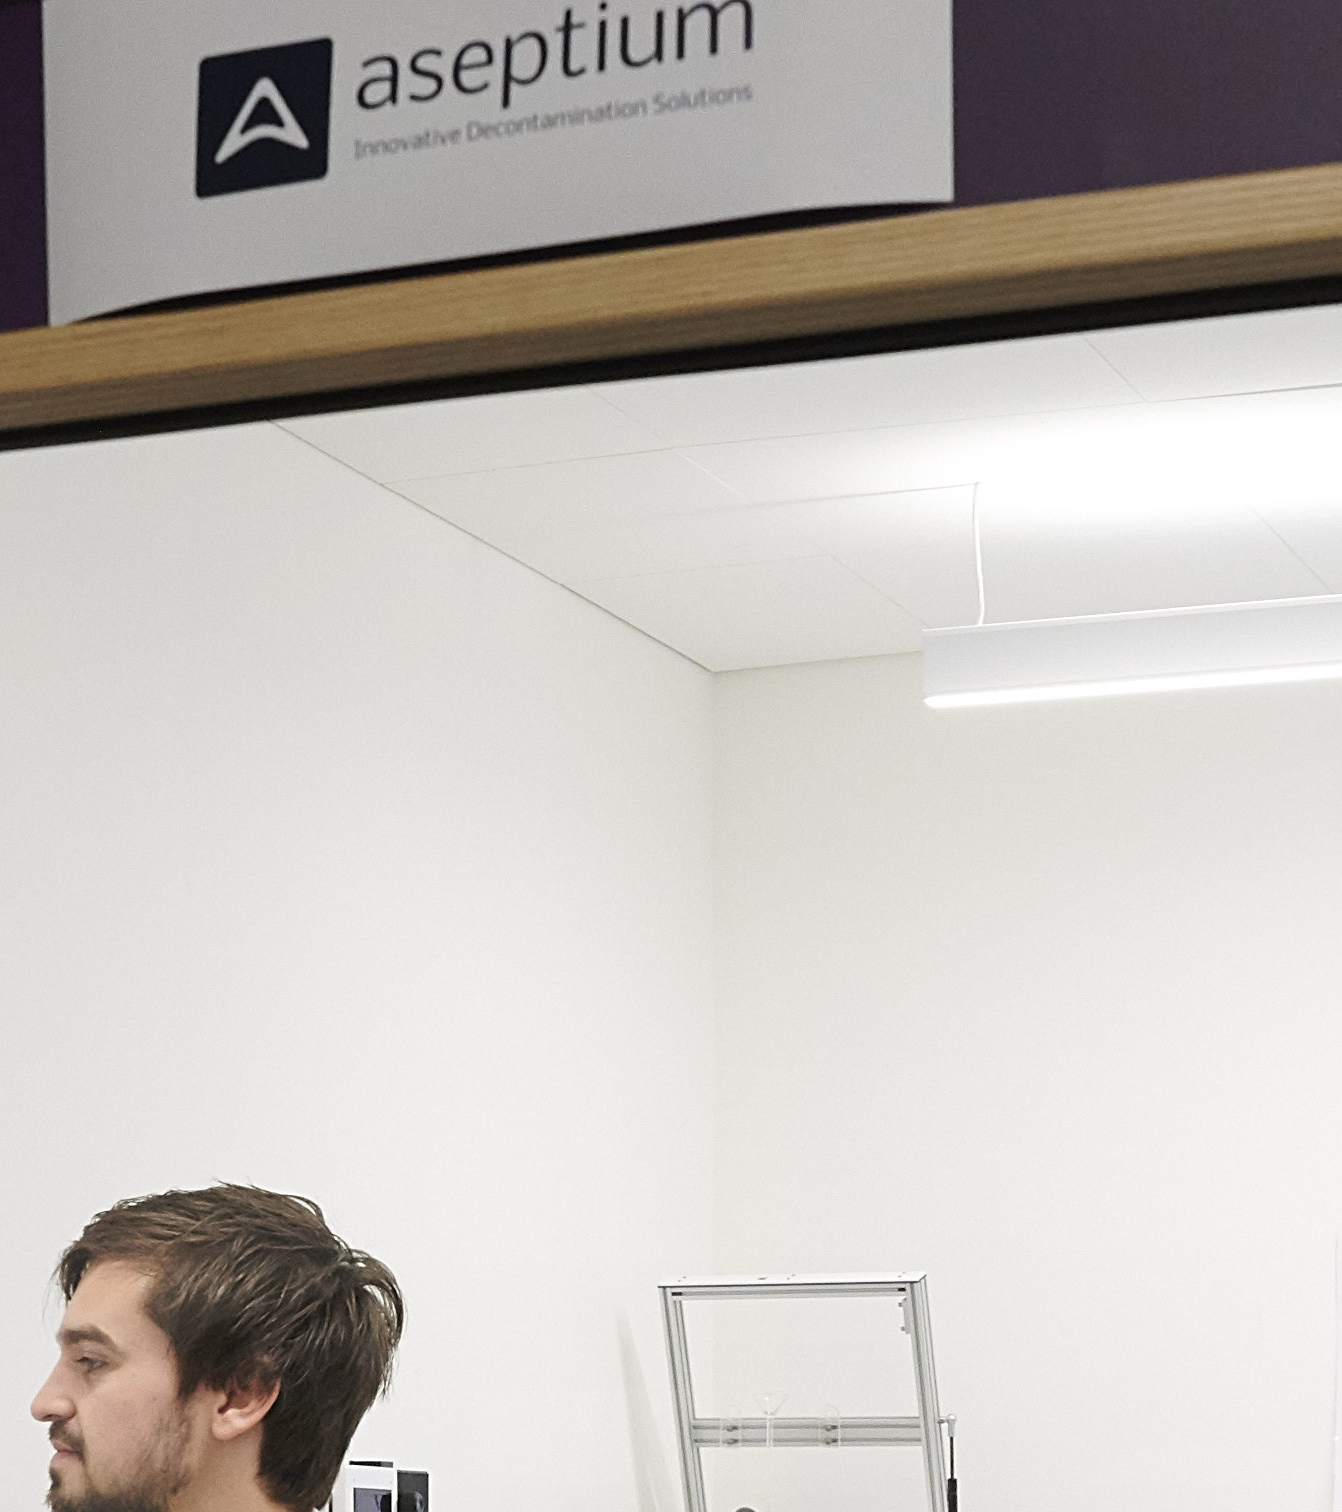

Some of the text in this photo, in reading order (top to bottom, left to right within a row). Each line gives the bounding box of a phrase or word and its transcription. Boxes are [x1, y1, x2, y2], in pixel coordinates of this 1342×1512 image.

[354, 84, 753, 160] Innovative Decontamination Solutions
